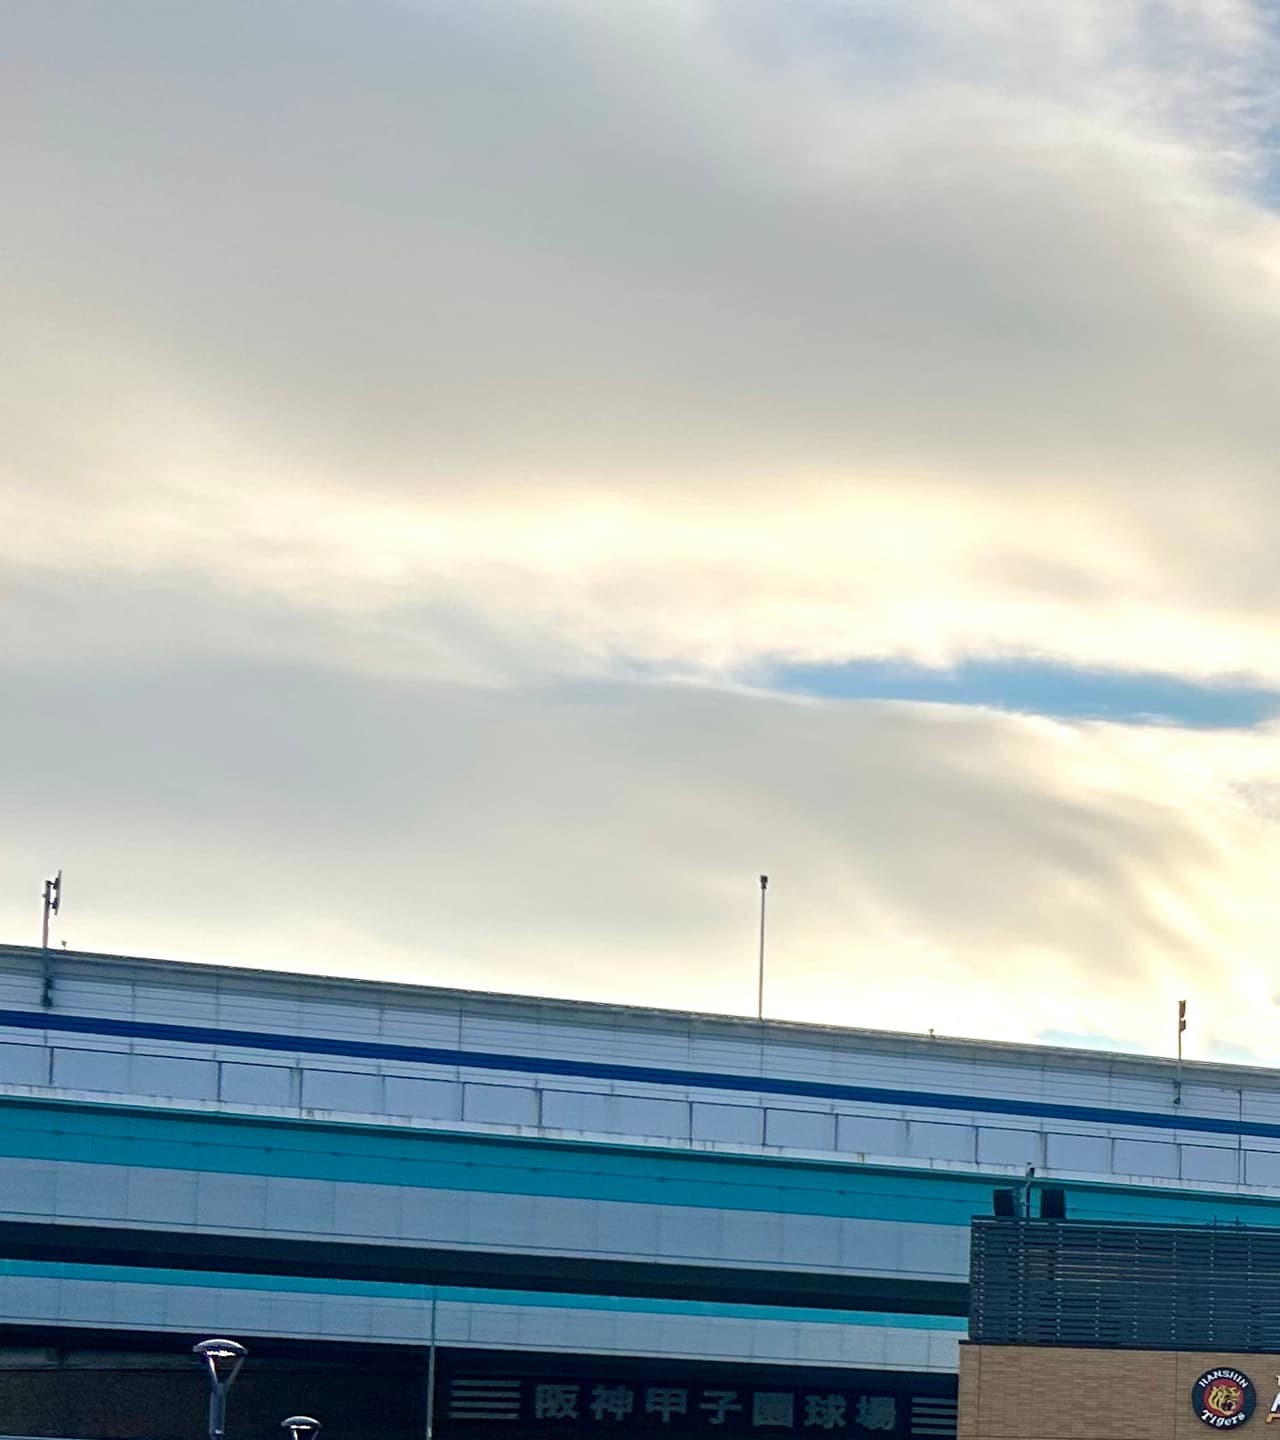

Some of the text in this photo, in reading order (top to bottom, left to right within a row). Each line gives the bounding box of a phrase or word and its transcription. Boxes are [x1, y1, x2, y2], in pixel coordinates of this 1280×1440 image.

[1198, 1369, 1249, 1388] HANSHIN
[534, 1383, 897, 1431] 阪神甲子園球場
[1201, 1409, 1246, 1427] Tigers
